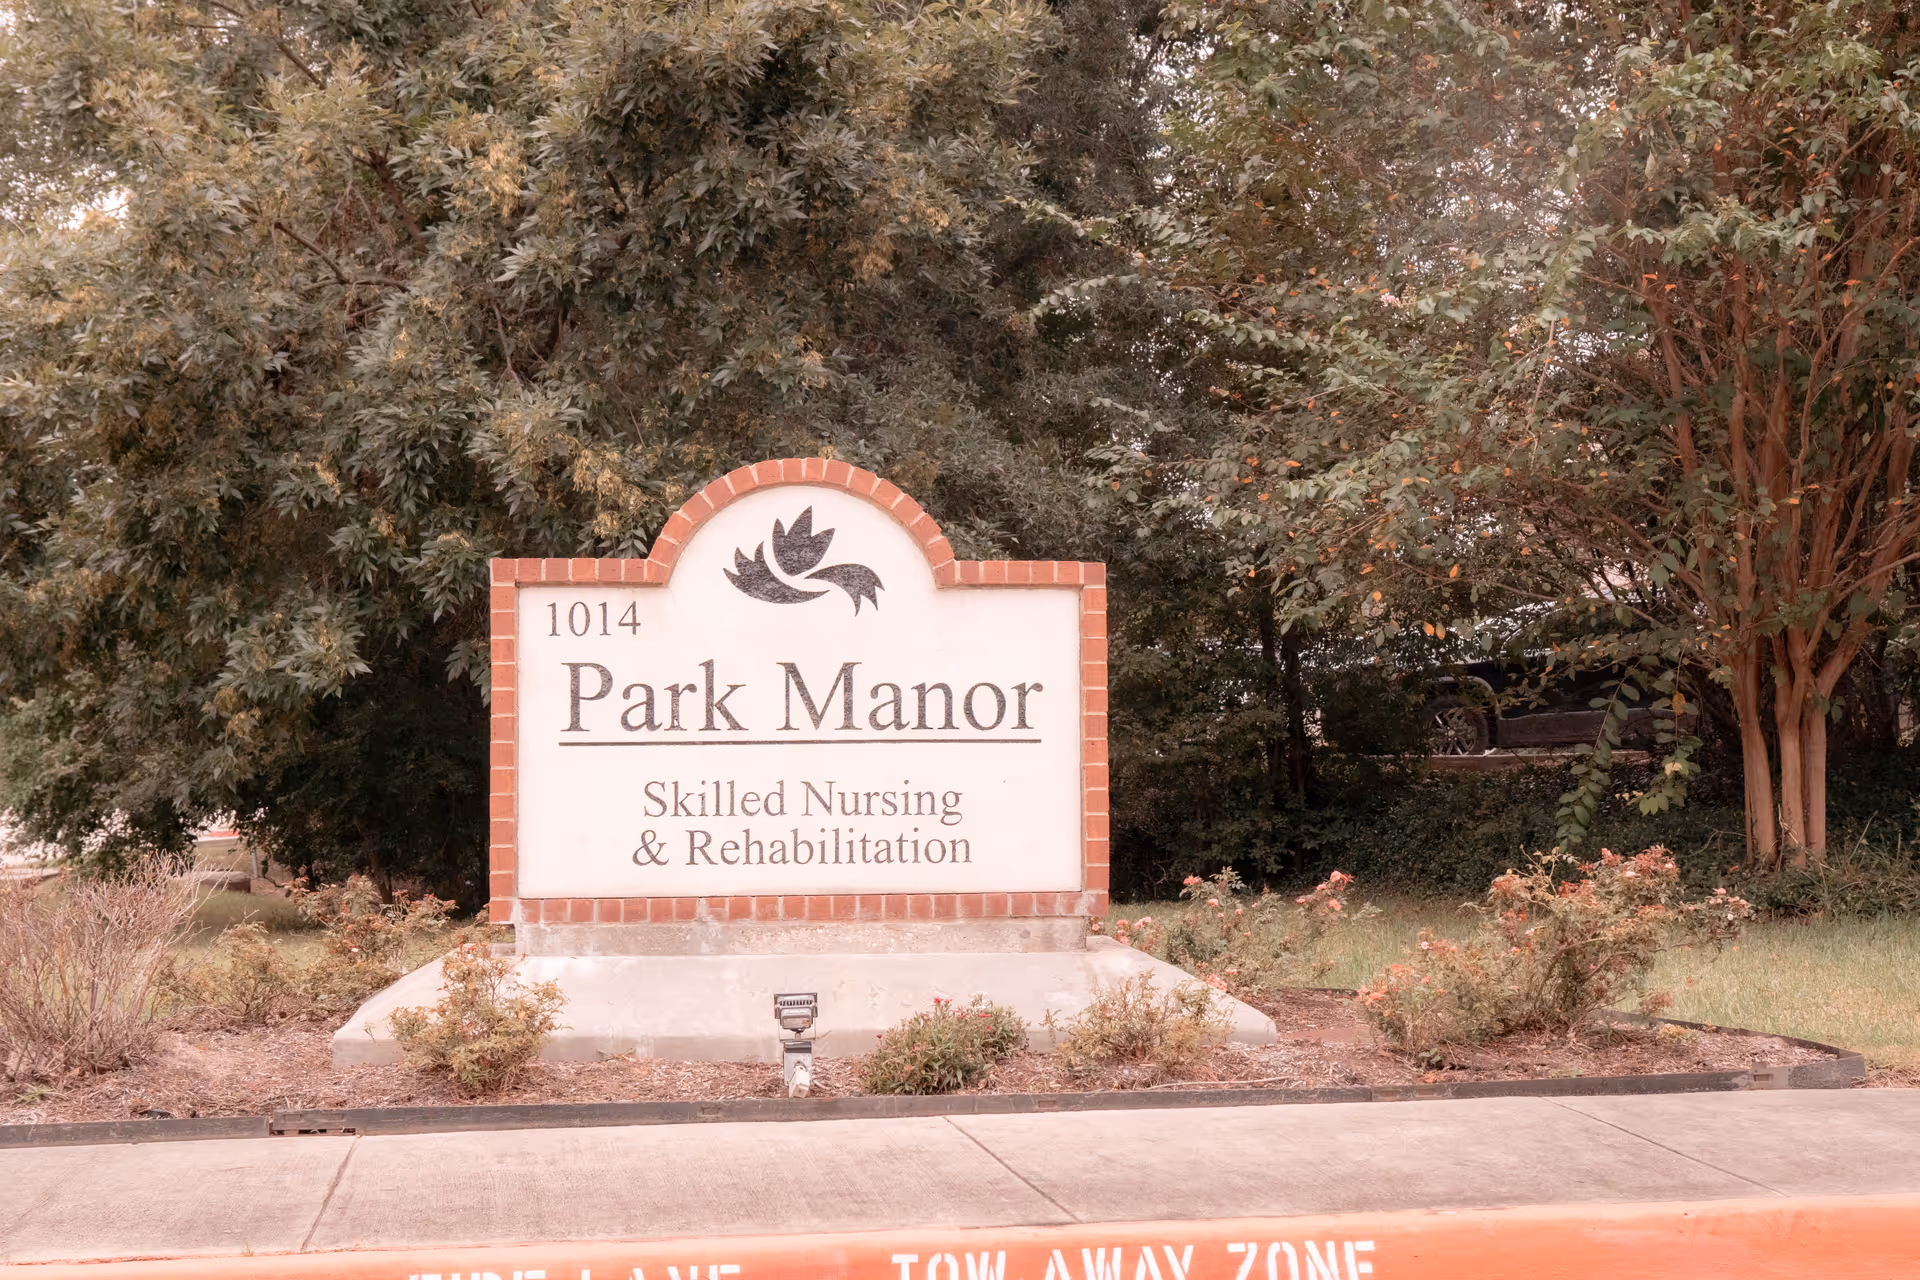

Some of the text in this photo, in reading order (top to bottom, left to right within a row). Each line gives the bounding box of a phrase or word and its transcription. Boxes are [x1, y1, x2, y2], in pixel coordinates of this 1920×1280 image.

[547, 601, 642, 637] 1014
[560, 659, 1044, 732] Park Manor
[643, 779, 963, 826] Skilled Nursing
[632, 828, 973, 866] & Rehabilitation
[1044, 1245, 1195, 1280] AWAY
[1227, 1240, 1375, 1280] ZONE
